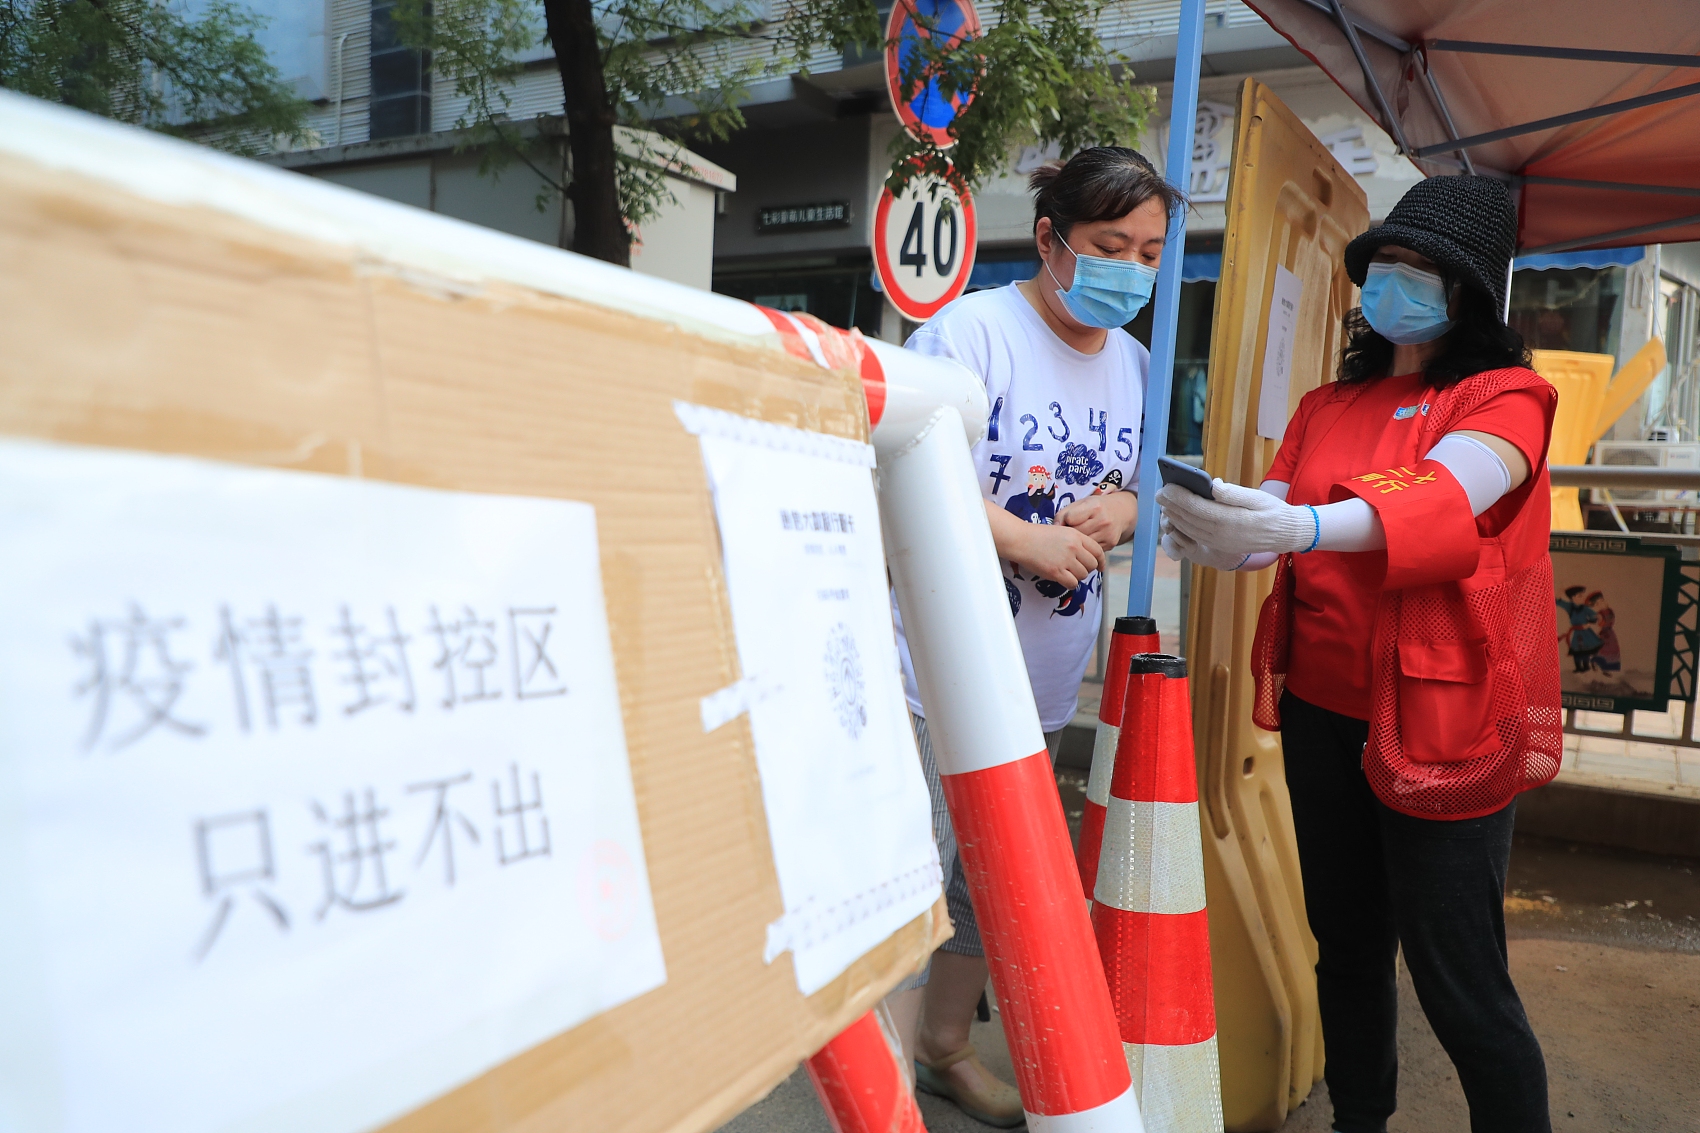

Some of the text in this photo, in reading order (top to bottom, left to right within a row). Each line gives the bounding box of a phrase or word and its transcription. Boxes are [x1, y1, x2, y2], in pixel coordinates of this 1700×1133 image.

[900, 197, 957, 277] 40
[1020, 413, 1044, 452] 2
[1048, 401, 1071, 443] 3
[1088, 407, 1107, 452] 4
[1114, 427, 1133, 462] 5
[1065, 455, 1089, 466] pirate
[1068, 464, 1091, 477] party
[66, 600, 569, 752] 疫情封控区
[191, 763, 554, 962] 只进不出
